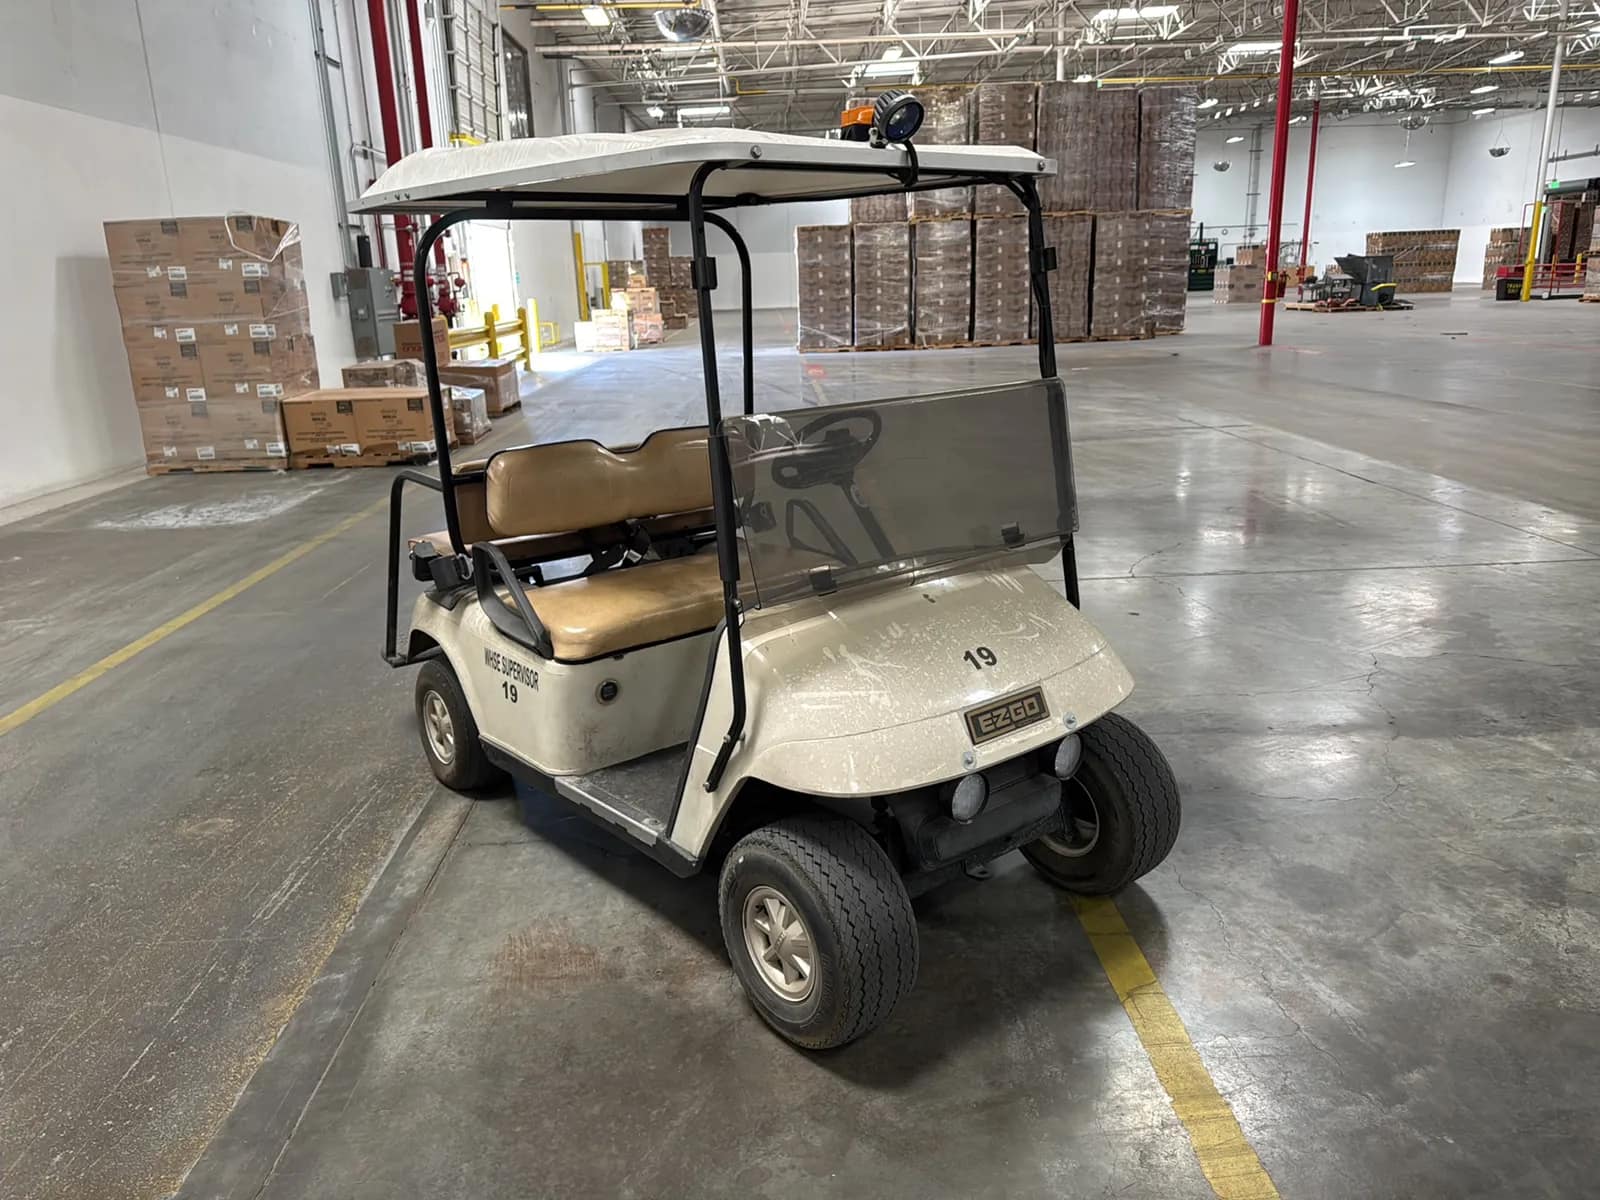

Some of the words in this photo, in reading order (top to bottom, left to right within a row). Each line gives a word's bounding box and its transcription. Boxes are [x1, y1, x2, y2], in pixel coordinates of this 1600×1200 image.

[485, 648, 501, 672] WHSE
[502, 656, 539, 692] SUPERVISOR
[963, 646, 997, 670] 19
[502, 681, 519, 704] 19
